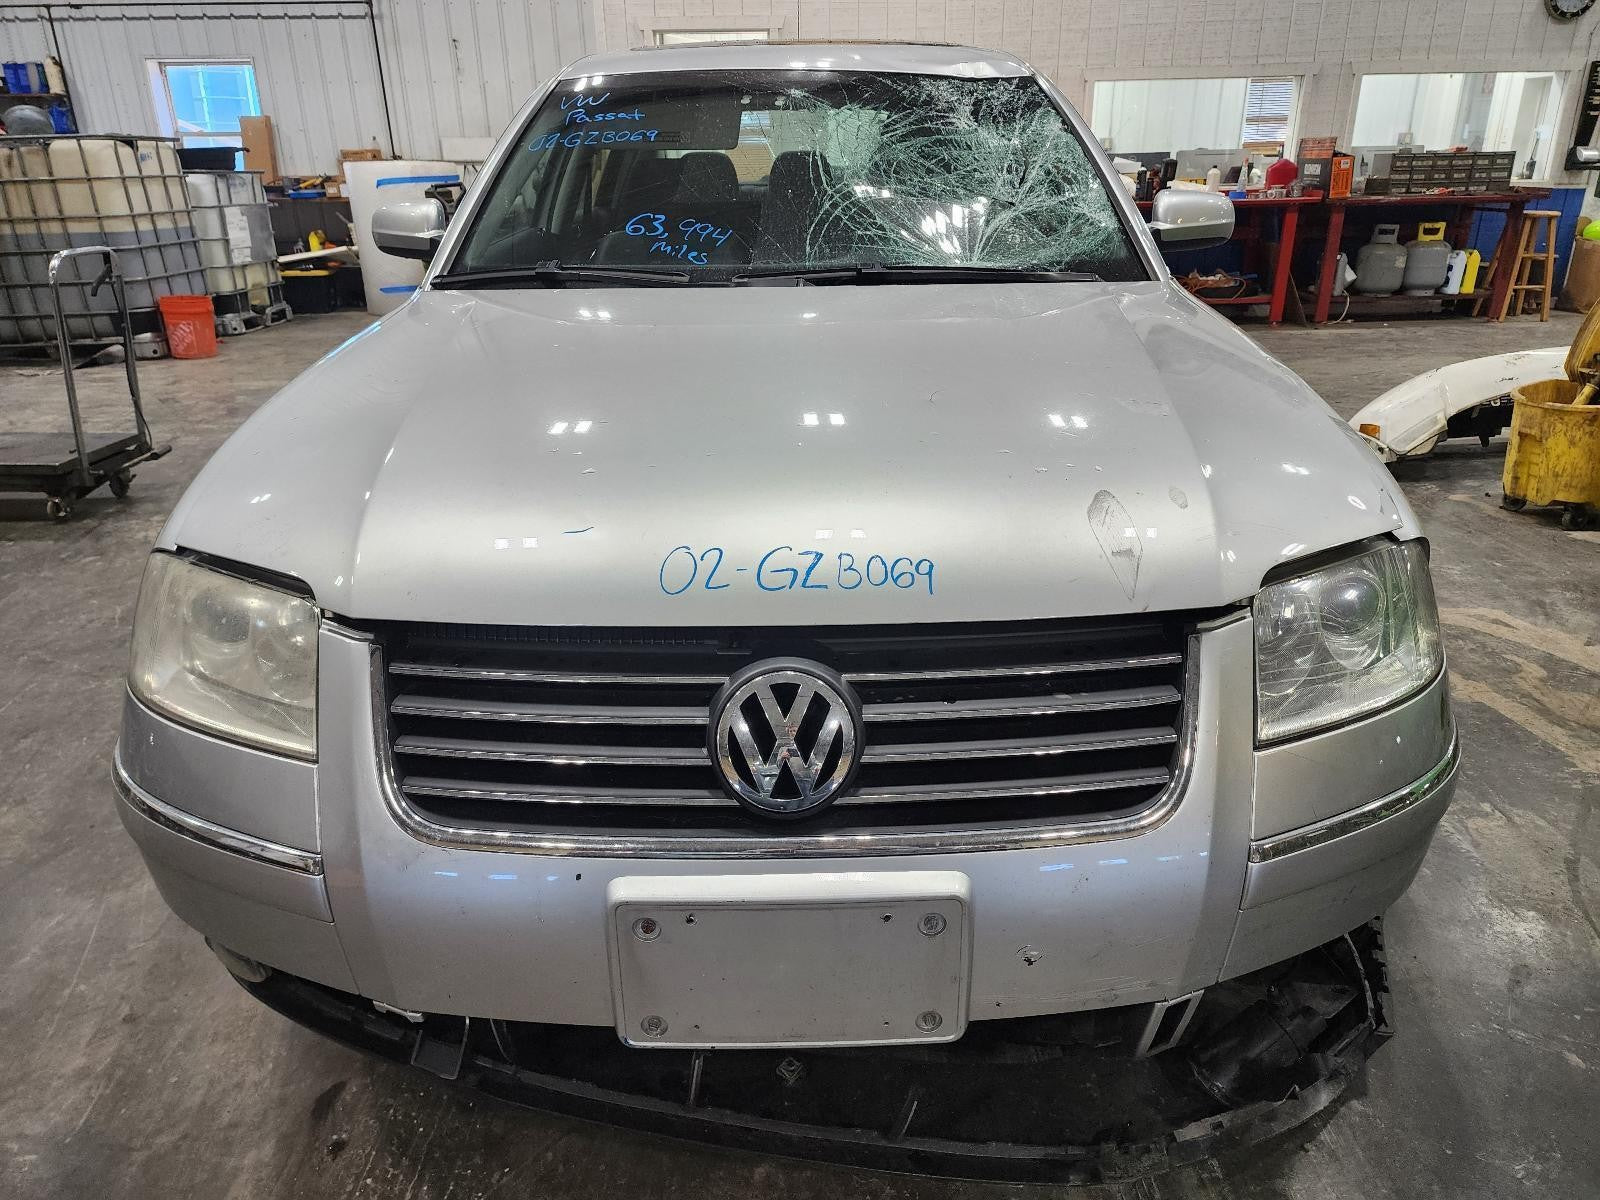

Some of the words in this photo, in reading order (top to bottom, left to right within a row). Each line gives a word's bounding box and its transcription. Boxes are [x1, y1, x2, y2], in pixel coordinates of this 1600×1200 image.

[566, 108, 645, 126] Passat
[528, 130, 657, 151] 02-GZB069
[659, 545, 935, 595] 02-GZB069
[717, 671, 854, 812] VW
